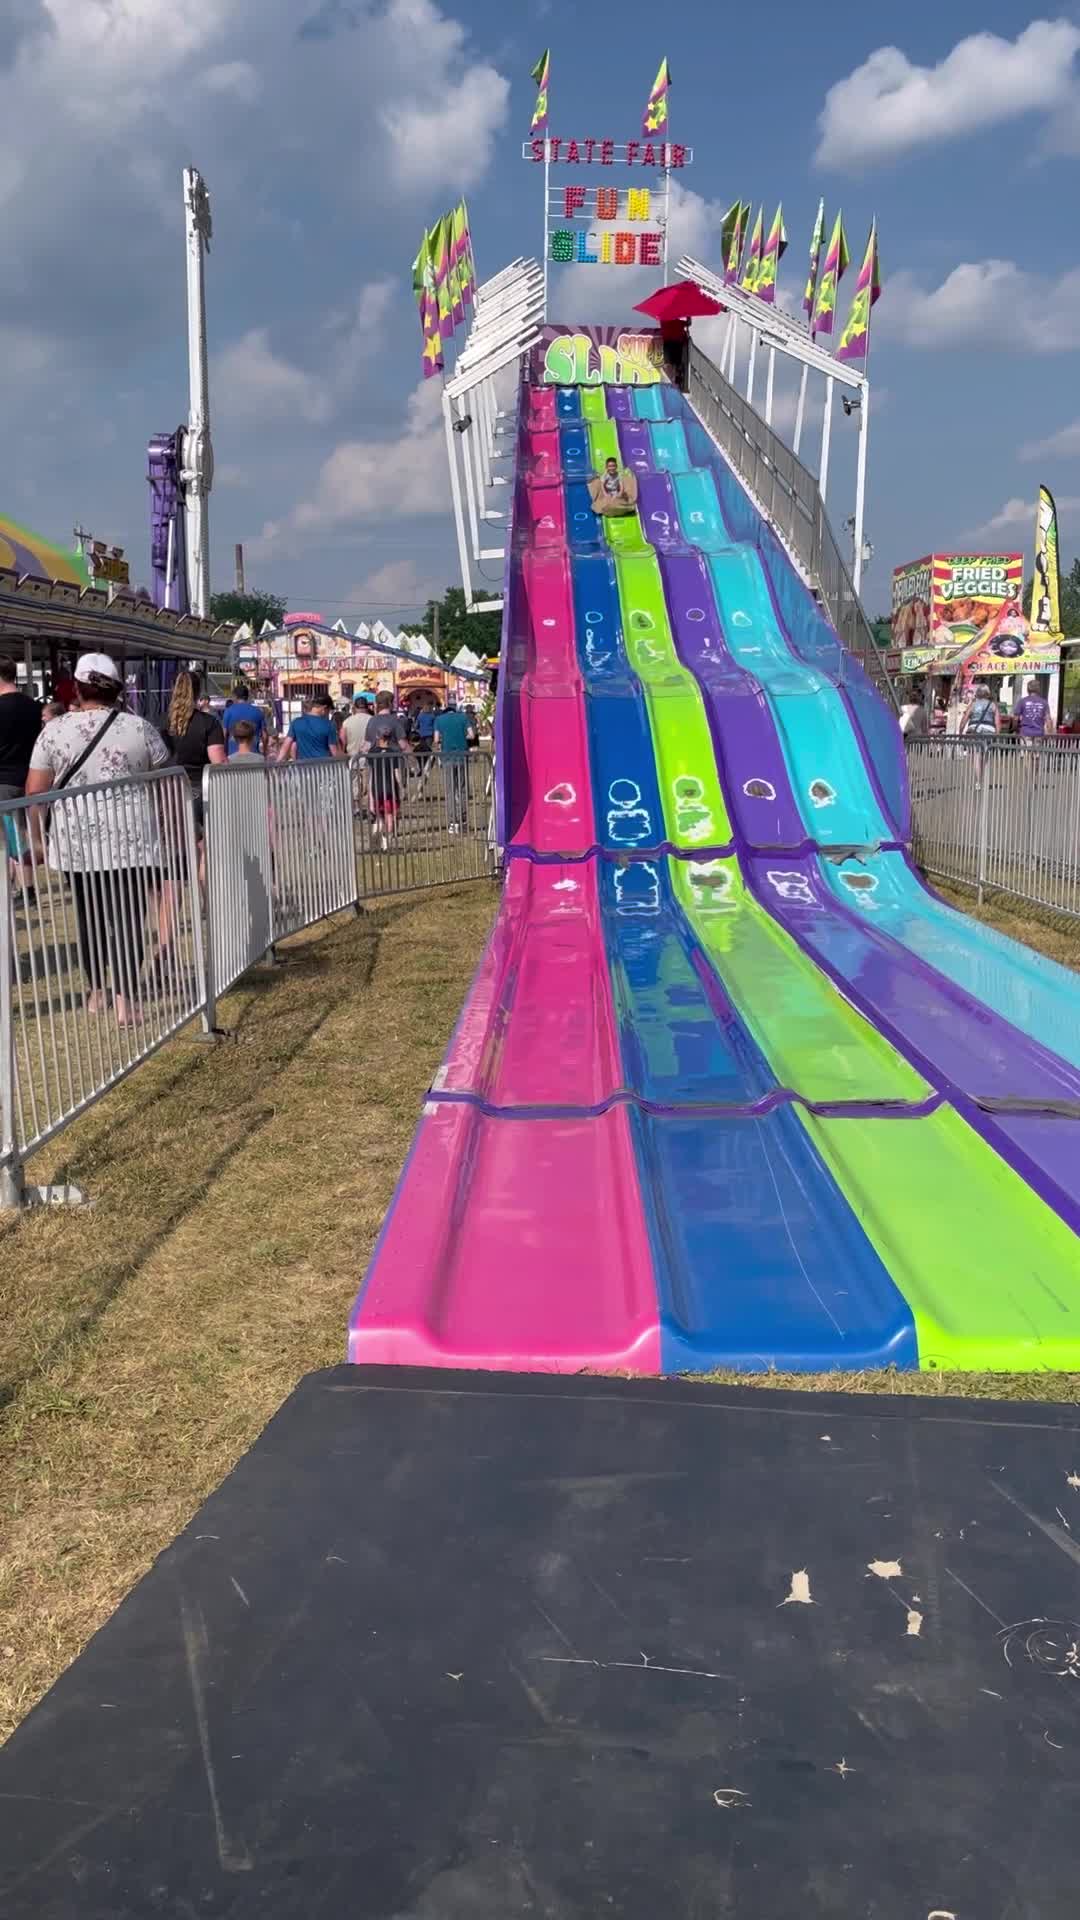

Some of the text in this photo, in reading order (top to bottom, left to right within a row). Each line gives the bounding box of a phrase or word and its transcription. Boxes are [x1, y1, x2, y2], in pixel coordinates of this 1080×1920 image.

[531, 138, 687, 168] STATE FAIR
[564, 185, 650, 221] FUN
[551, 229, 663, 265] SLIDE
[979, 555, 1012, 565] FRIED
[951, 566, 1008, 581] FRIED
[940, 580, 1018, 601] VEGGIES
